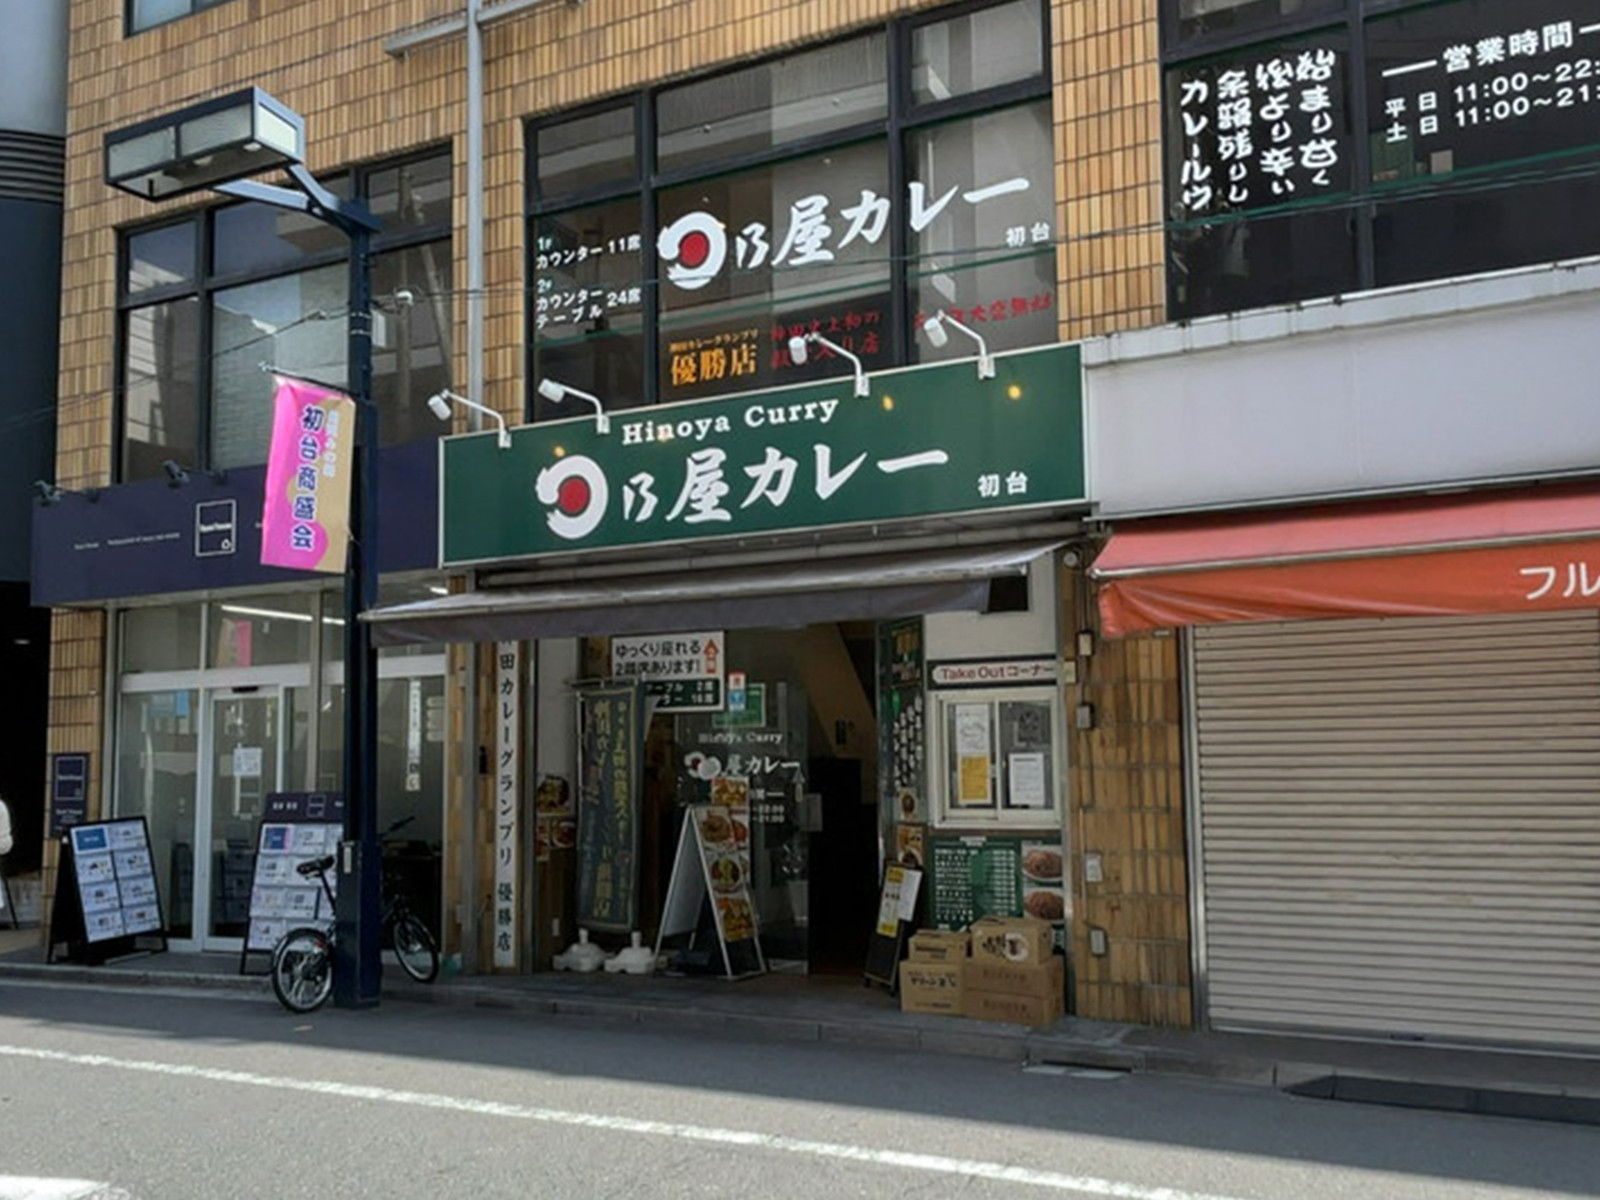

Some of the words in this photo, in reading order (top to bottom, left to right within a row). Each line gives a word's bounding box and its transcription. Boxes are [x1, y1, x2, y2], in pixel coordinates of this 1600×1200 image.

[1443, 21, 1574, 73] 営業時間
[1385, 91, 1438, 118] 平日
[1386, 115, 1439, 143] 土日
[1006, 222, 1050, 247] 初台
[536, 246, 603, 269] カウンター
[536, 289, 603, 312] カウンター
[671, 344, 757, 386] 優勝店
[622, 416, 731, 445] Hinoya
[744, 399, 839, 427] Curry
[977, 472, 1029, 497] 初台
[941, 666, 976, 680] Take
[978, 665, 1005, 679] Out
[1007, 663, 1055, 677] コーナー
